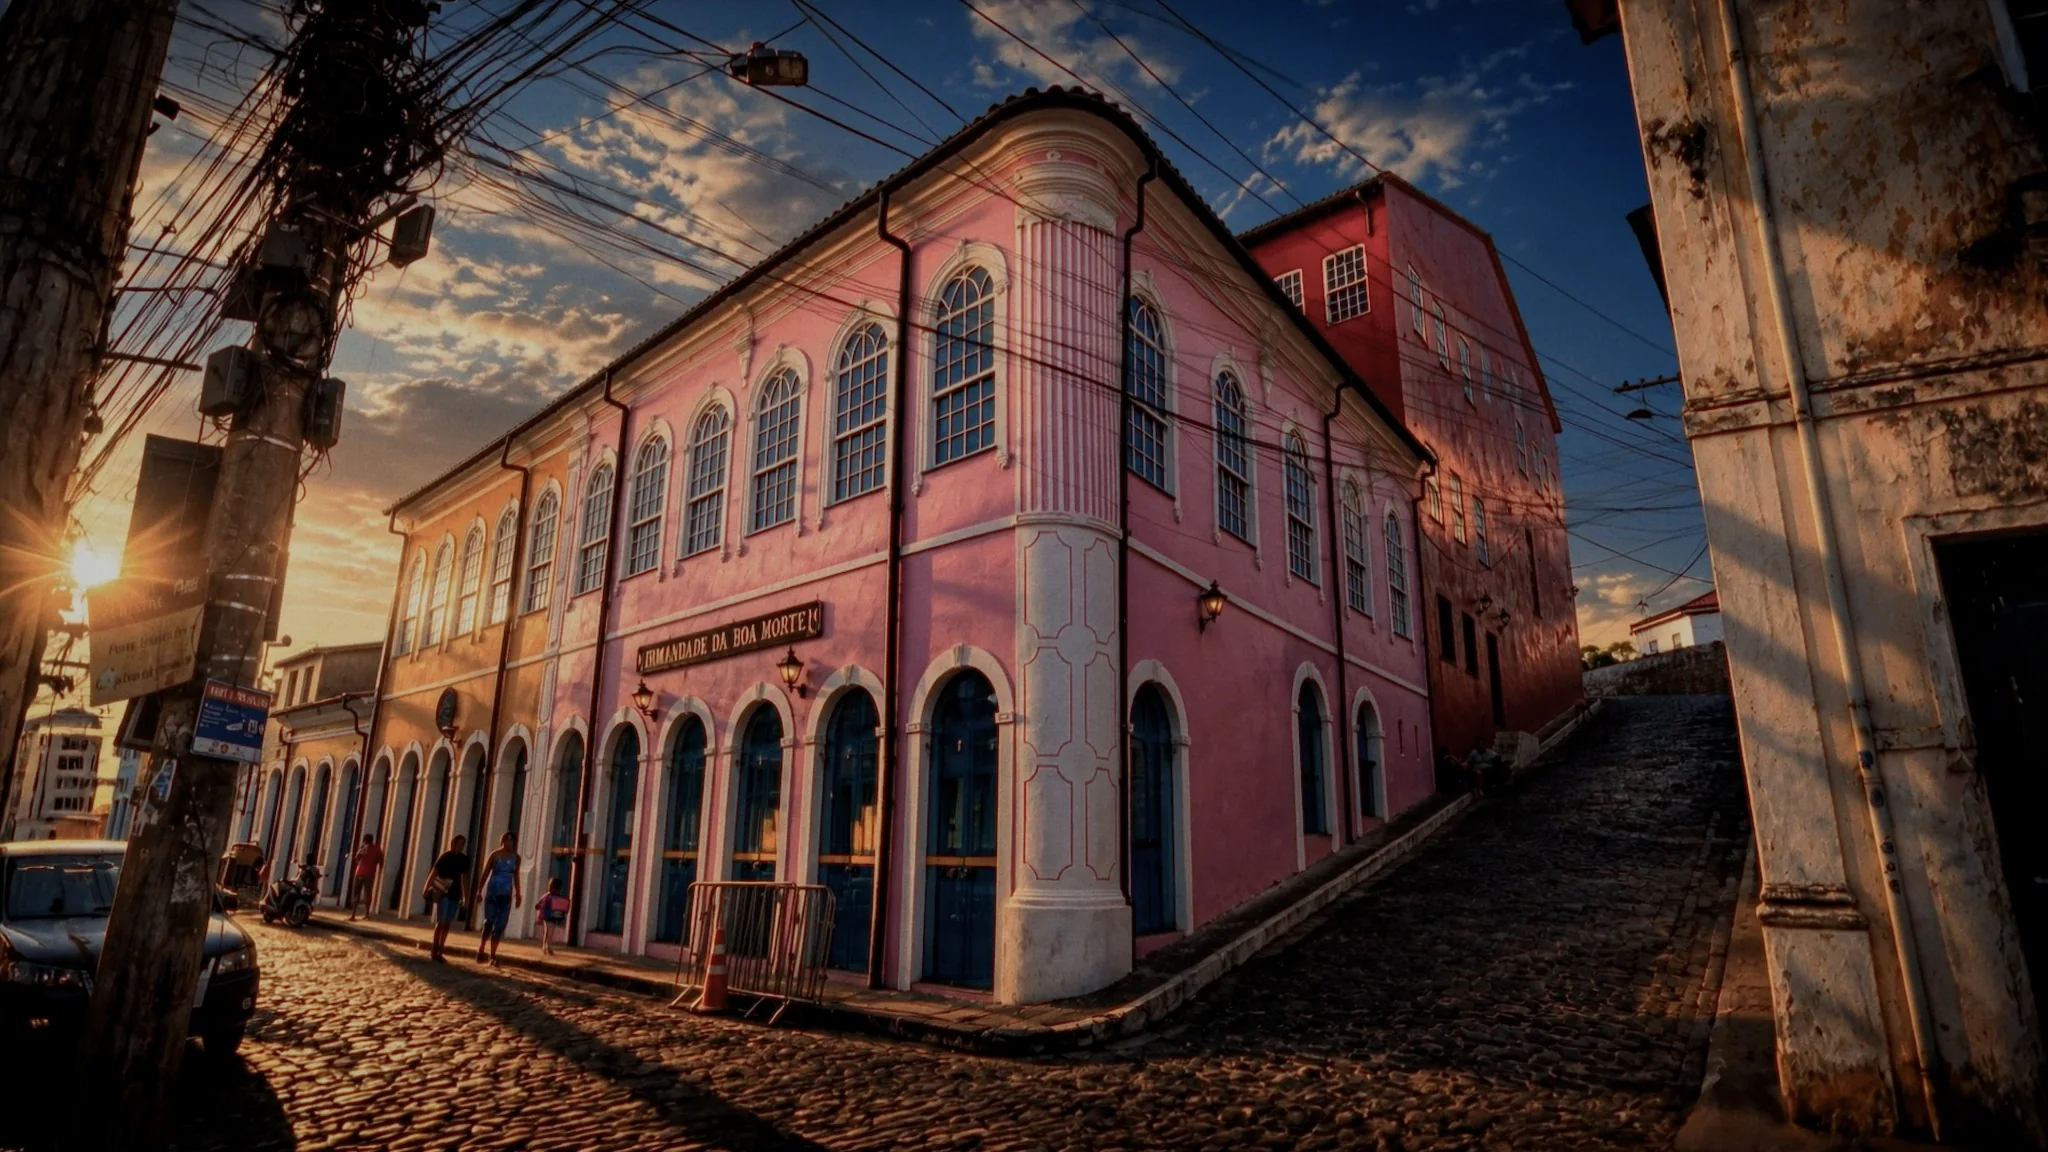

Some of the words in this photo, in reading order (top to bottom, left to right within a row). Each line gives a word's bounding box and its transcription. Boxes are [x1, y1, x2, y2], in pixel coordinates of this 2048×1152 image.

[645, 635, 708, 669] IRMANDADE
[712, 633, 728, 652] DA
[733, 626, 757, 648] BOA
[761, 612, 807, 644] MORTE
